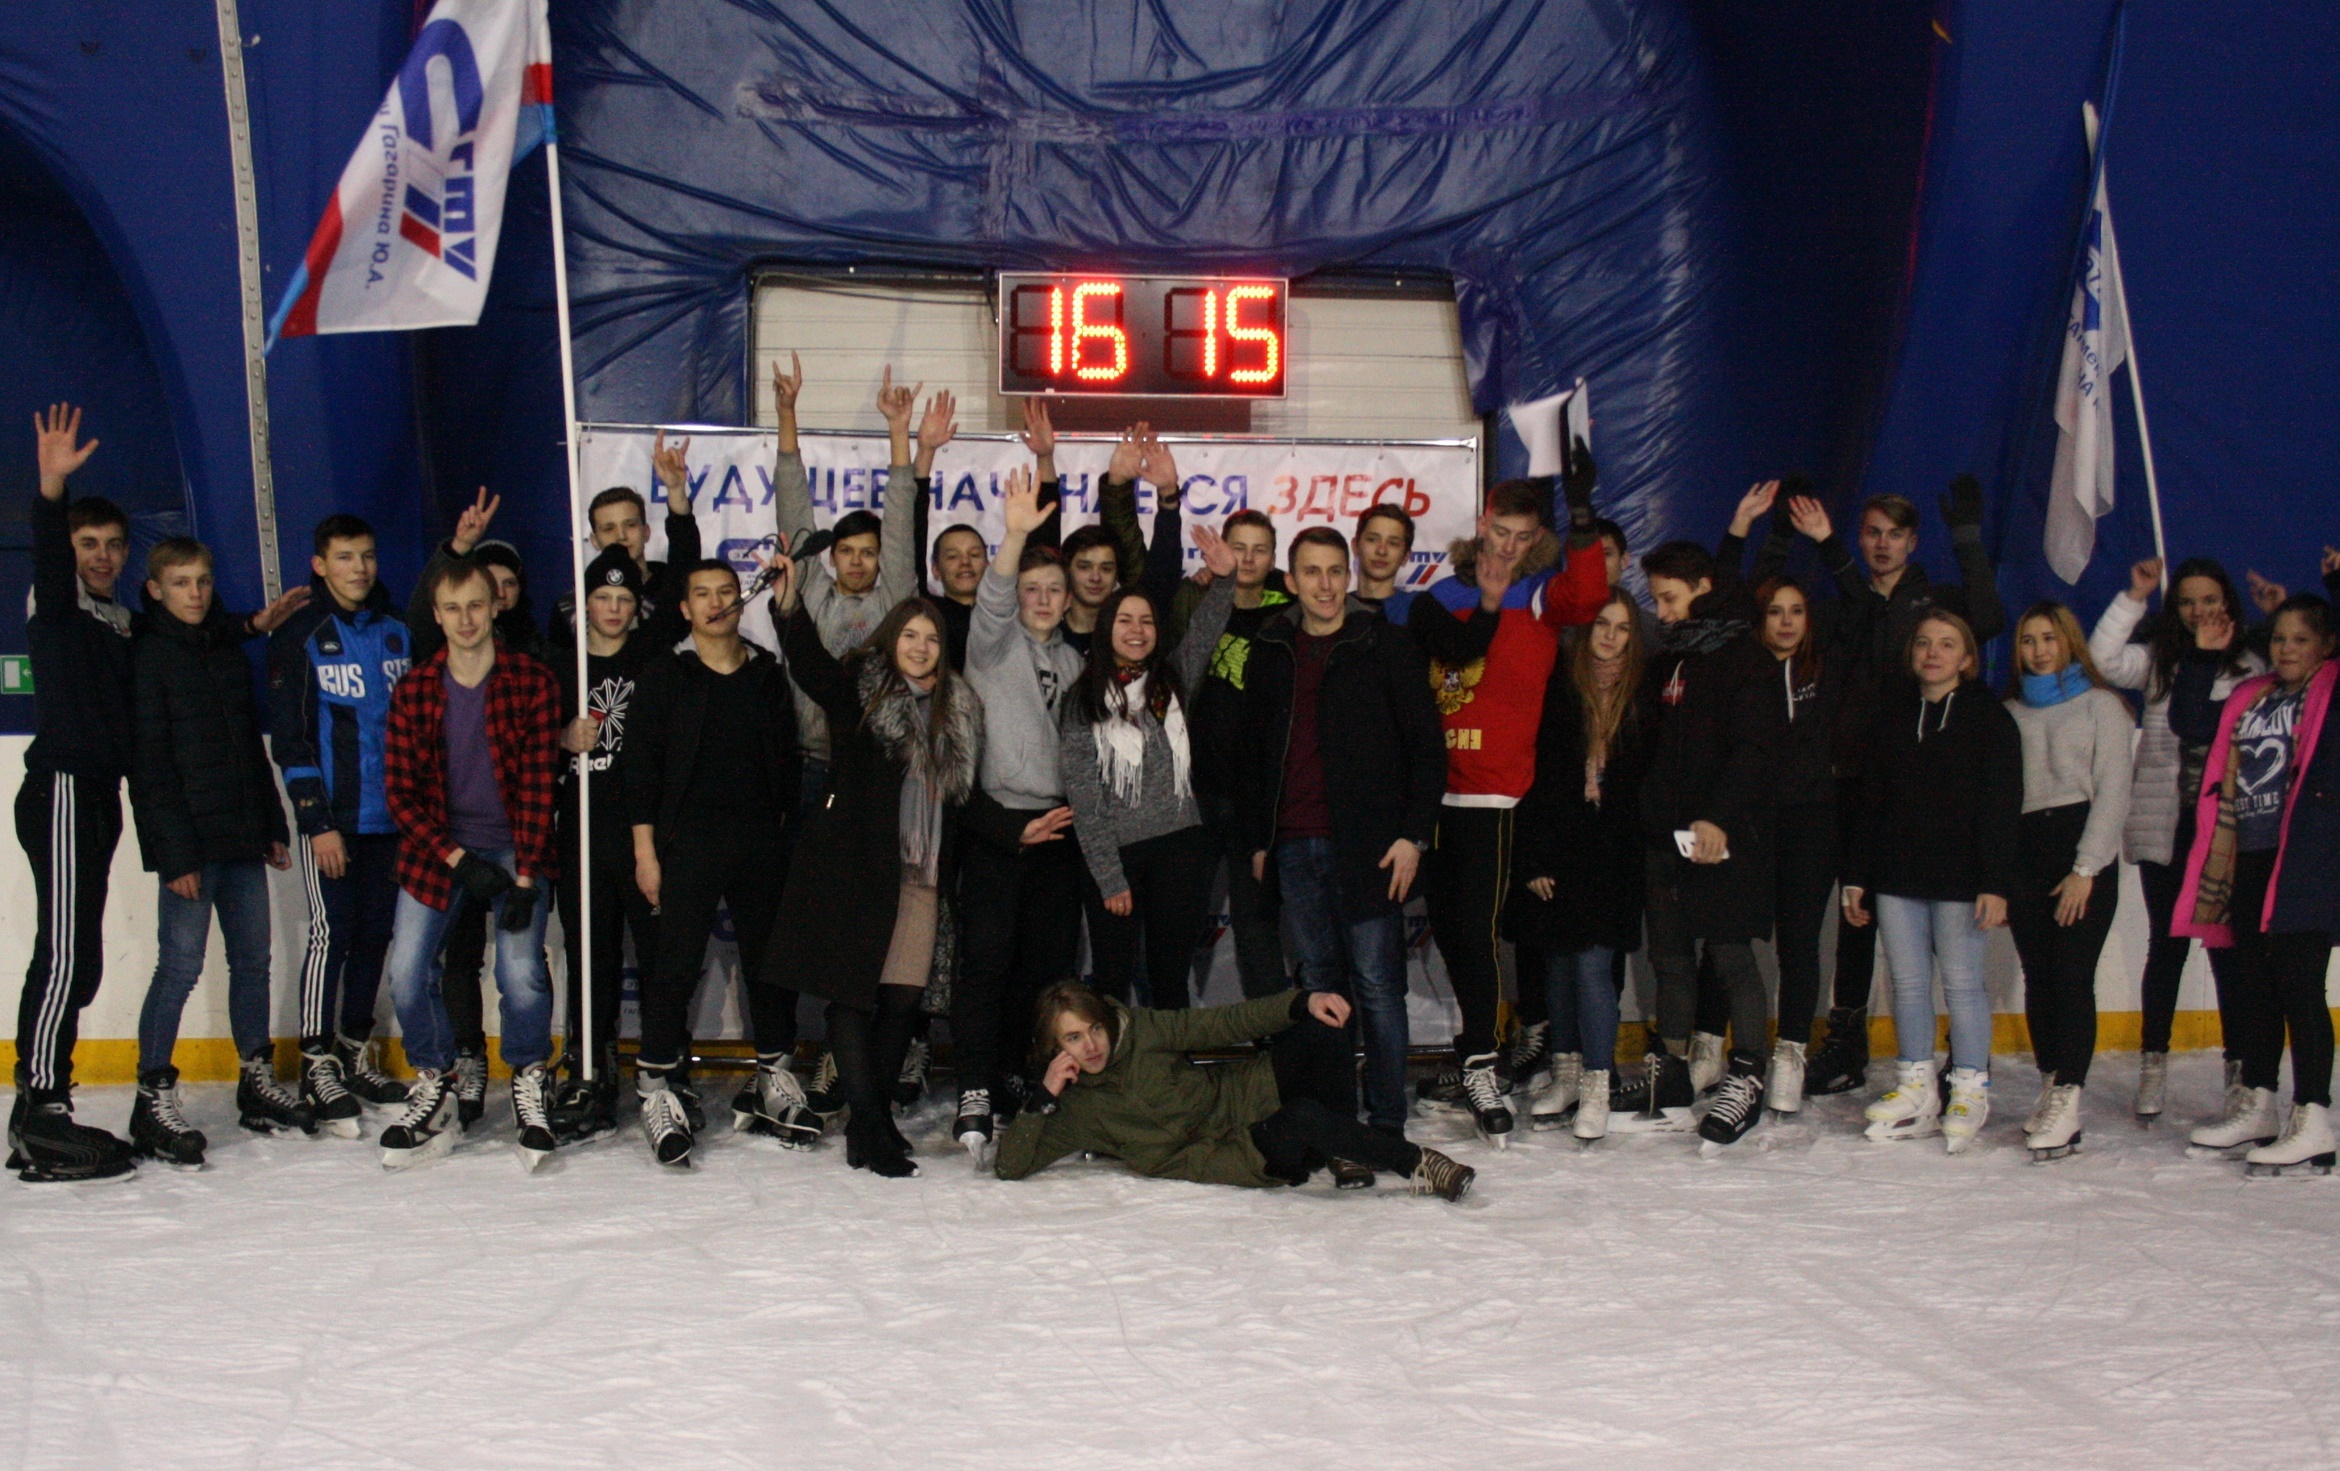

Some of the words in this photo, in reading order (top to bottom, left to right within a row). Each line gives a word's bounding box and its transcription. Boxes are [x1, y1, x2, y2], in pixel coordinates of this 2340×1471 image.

[1051, 282, 1126, 380] 16
[1205, 285, 1278, 383] 15
[317, 663, 366, 698] RUS
